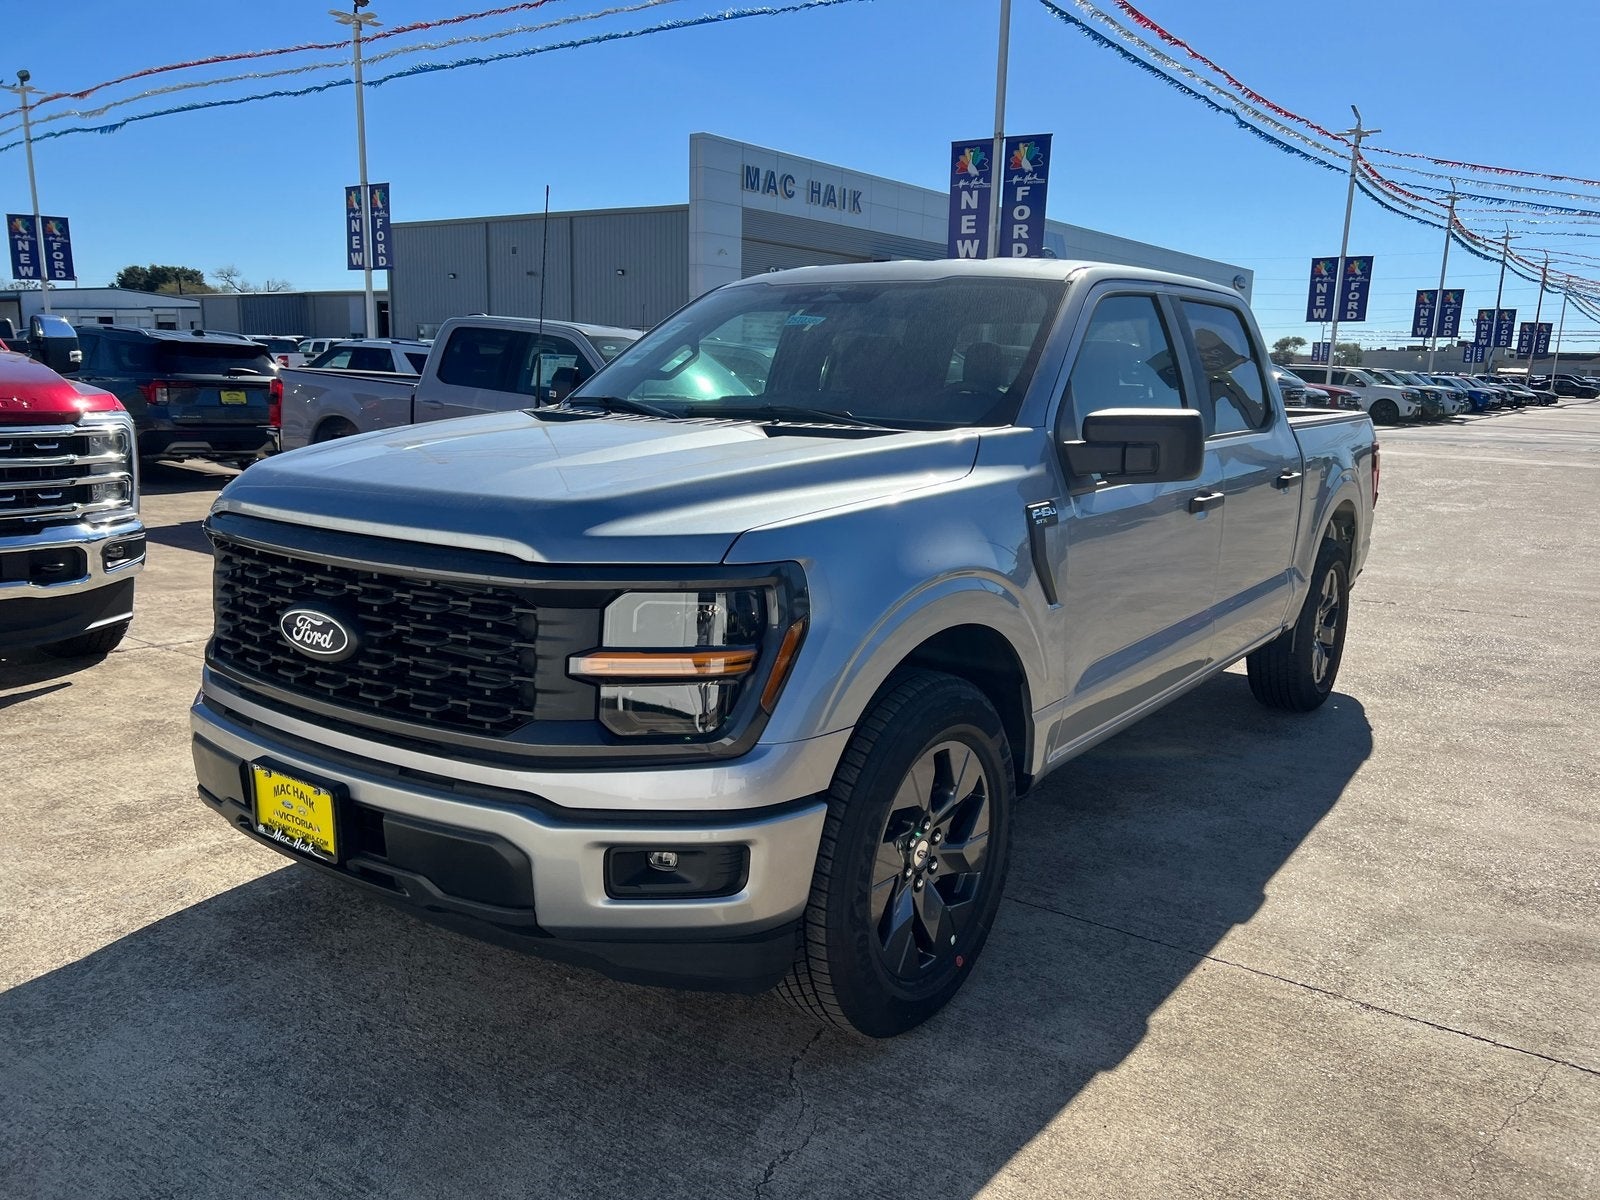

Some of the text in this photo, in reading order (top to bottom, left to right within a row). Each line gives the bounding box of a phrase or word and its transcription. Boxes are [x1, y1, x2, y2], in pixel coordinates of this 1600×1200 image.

[743, 164, 863, 213] MAC HAIK
[956, 190, 980, 259] NEW
[1012, 186, 1032, 258] FORD
[17, 240, 34, 277] NEW
[350, 219, 363, 266] NEW
[376, 218, 387, 267] FORD
[52, 242, 67, 279] FORD
[1312, 282, 1328, 319] NEW
[1346, 282, 1361, 320] FORD
[1416, 308, 1430, 336] NEW
[1443, 308, 1455, 336] FORD
[1478, 324, 1488, 346] NEW
[1500, 323, 1509, 346] FORD
[1520, 334, 1530, 353] NEW
[1537, 335, 1546, 354] FORD
[292, 615, 334, 649] Ford
[273, 784, 292, 798] MAC
[292, 785, 316, 813] HAIK
[272, 829, 291, 843] Mac
[280, 811, 316, 832] VICTORIA
